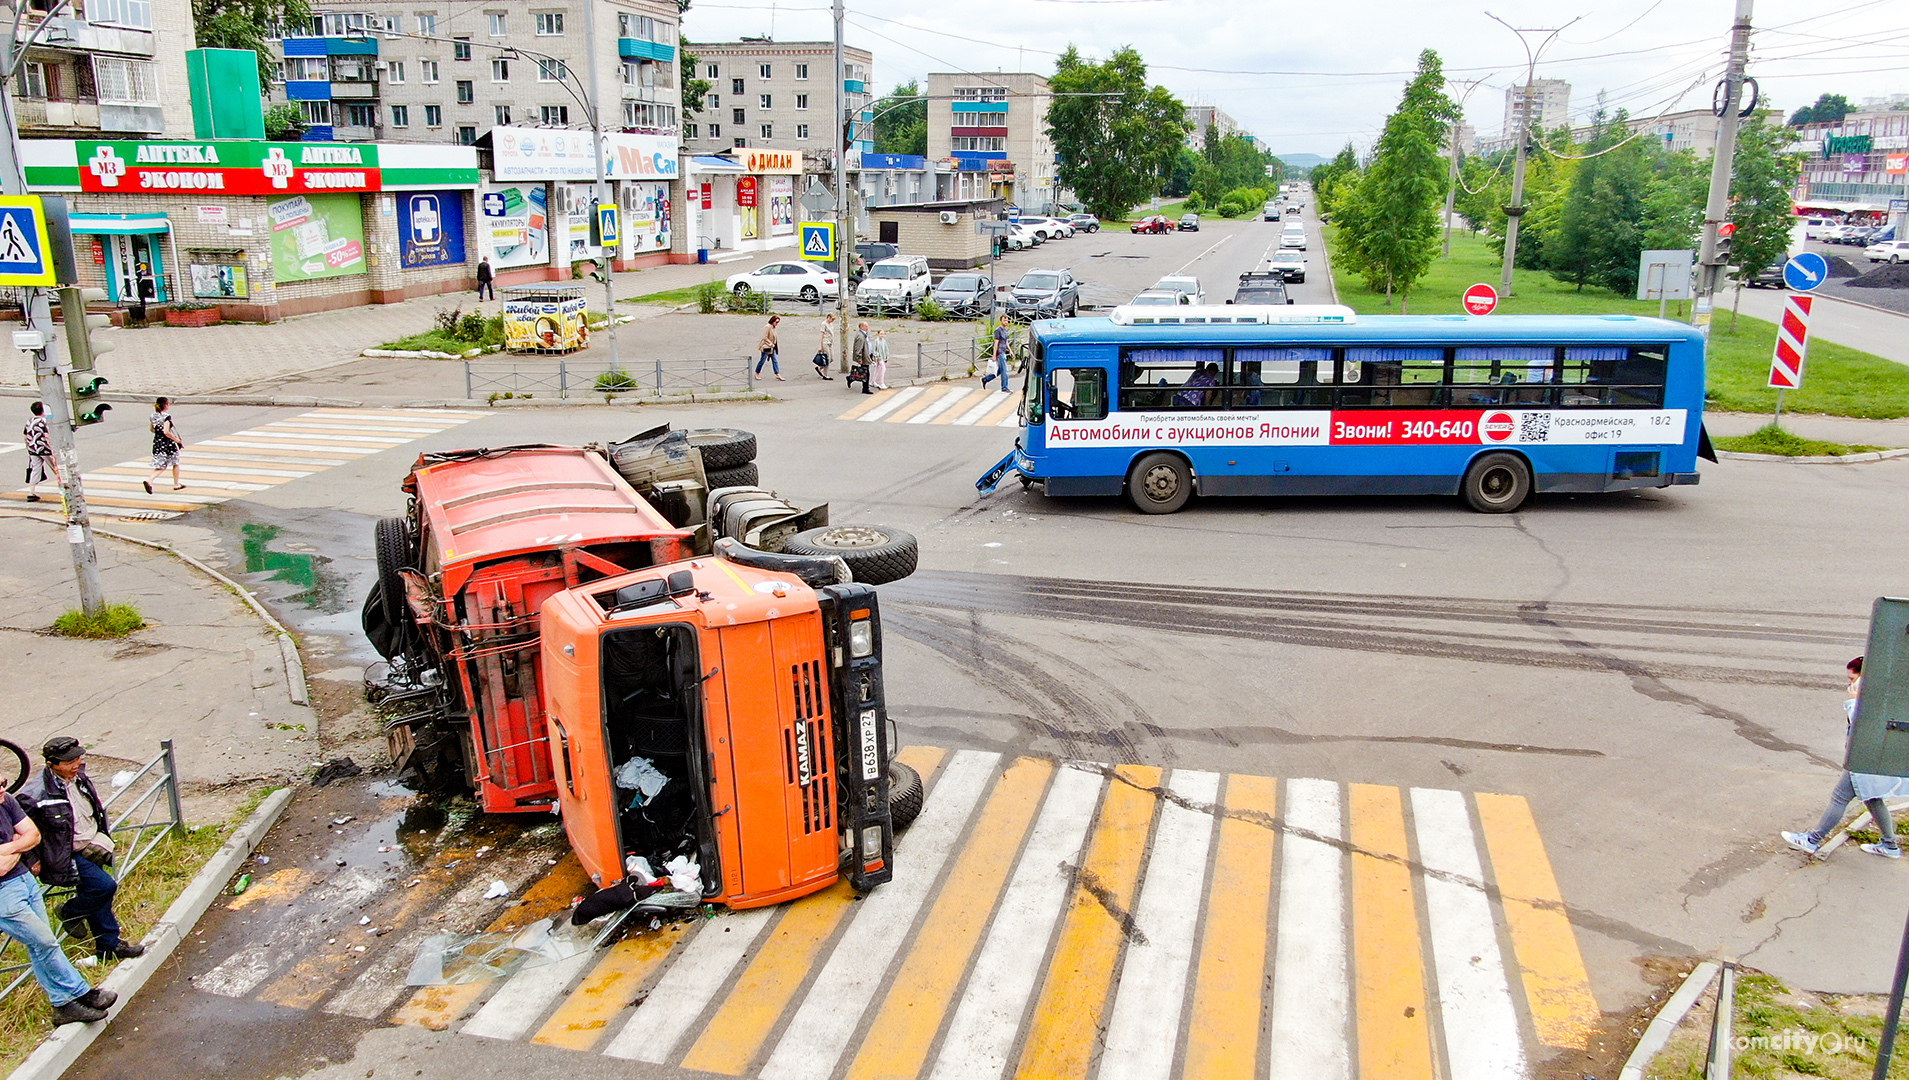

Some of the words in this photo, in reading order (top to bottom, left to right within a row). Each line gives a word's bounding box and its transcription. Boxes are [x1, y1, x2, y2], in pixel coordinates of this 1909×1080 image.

[136, 145, 220, 163] АПТЕКА
[301, 147, 363, 164] АПТЕКА
[617, 145, 677, 174] MaCar
[759, 153, 792, 170] ДИЛАН
[503, 166, 544, 175] АВТОЗАПЧАСТИ
[139, 172, 225, 189] ЭКОНОМ
[304, 172, 366, 188] ЭКОНОМ
[272, 197, 303, 215] ПОКУПАЙ
[286, 207, 309, 219] ПОЛЦЕНЫ
[328, 249, 349, 264] -50%
[506, 303, 540, 315] Живой
[562, 303, 578, 314] Живой
[517, 313, 536, 322] квас
[1140, 414, 1176, 422] Приобрети
[1554, 416, 1636, 427] Красноармейская,
[1650, 416, 1671, 426] 18/2
[1050, 424, 1151, 441] Автомобили
[1155, 428, 1163, 440] с
[1168, 426, 1254, 443] аукционов
[1259, 423, 1320, 439] Японии
[1334, 421, 1392, 439] Звони!
[1401, 420, 1473, 439] 340-640
[1584, 430, 1608, 440] офис
[1611, 430, 1622, 439] 19
[794, 720, 811, 787] KAMAZ
